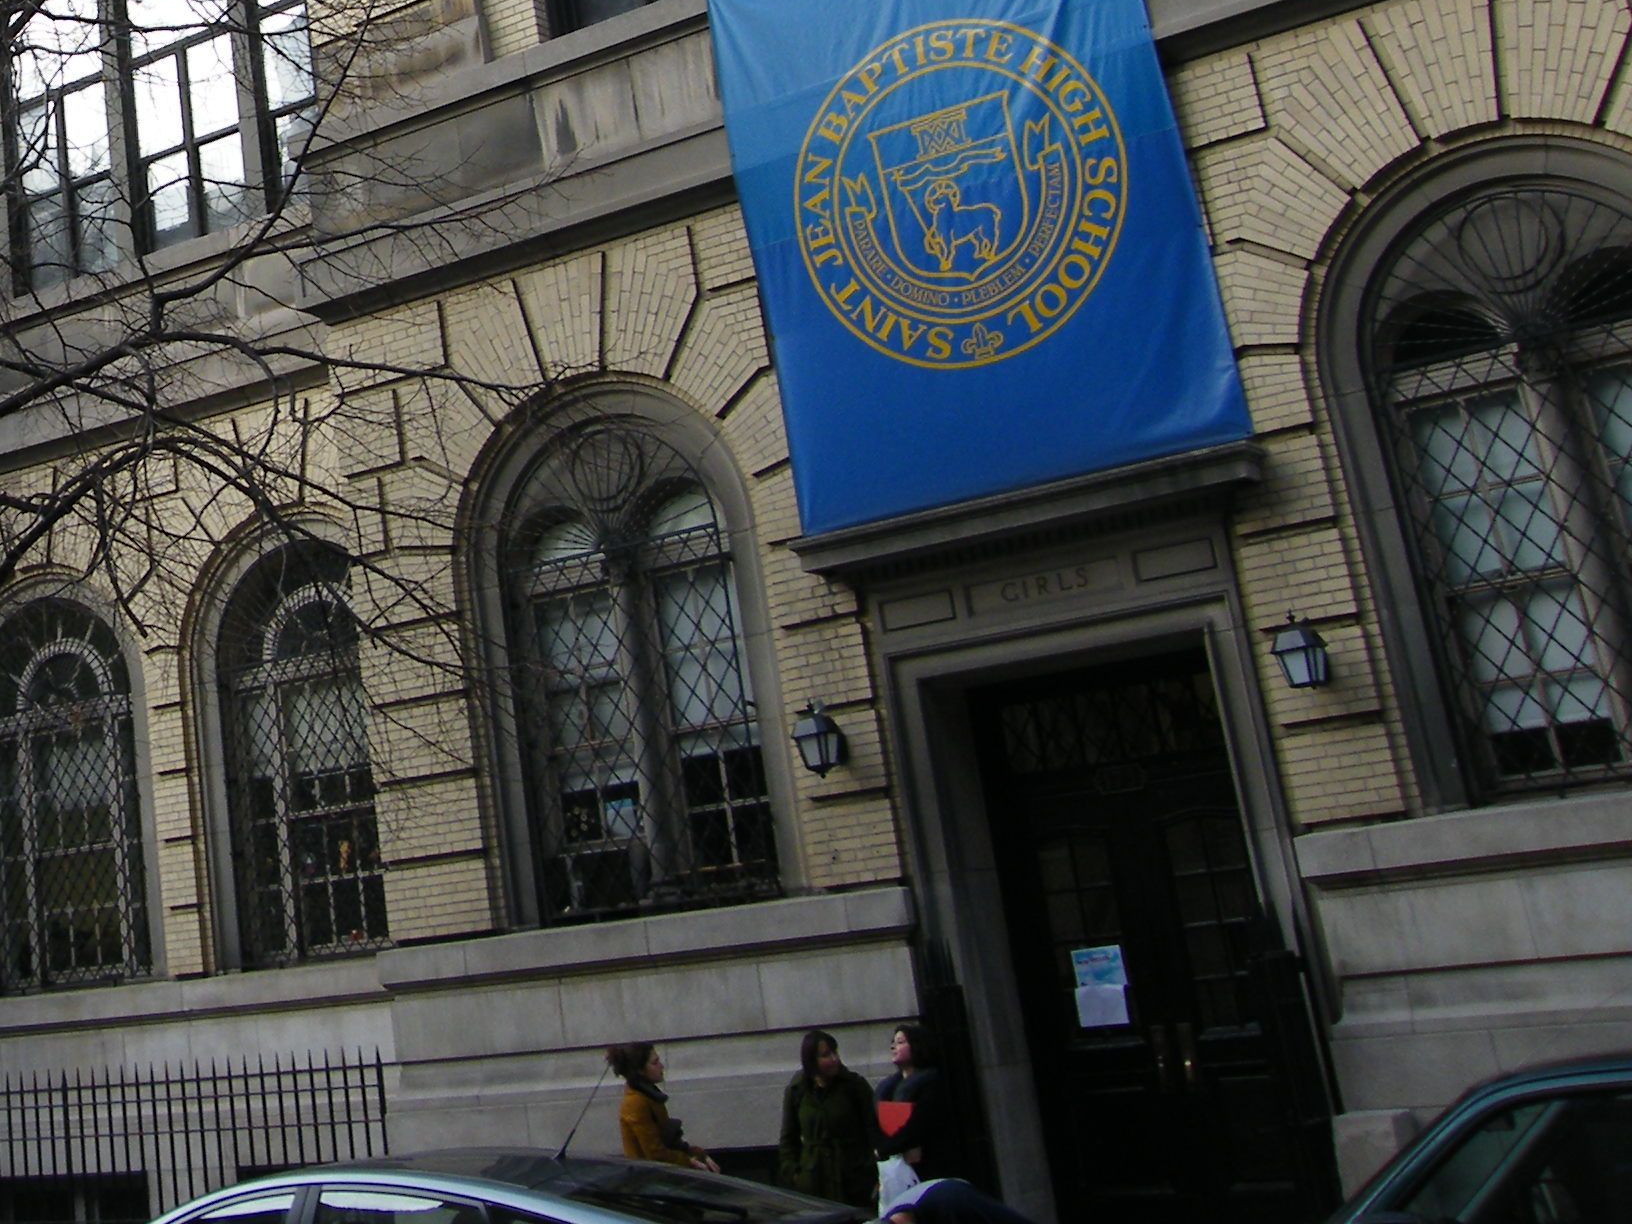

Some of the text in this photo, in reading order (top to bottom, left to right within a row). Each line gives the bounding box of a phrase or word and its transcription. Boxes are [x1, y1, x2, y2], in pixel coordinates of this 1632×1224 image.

[802, 27, 1119, 360] SAINT JEAN BAPTISTE HIGH SCHOOL
[890, 276, 949, 306] DOMINO
[1000, 567, 1089, 602] GIRLS
